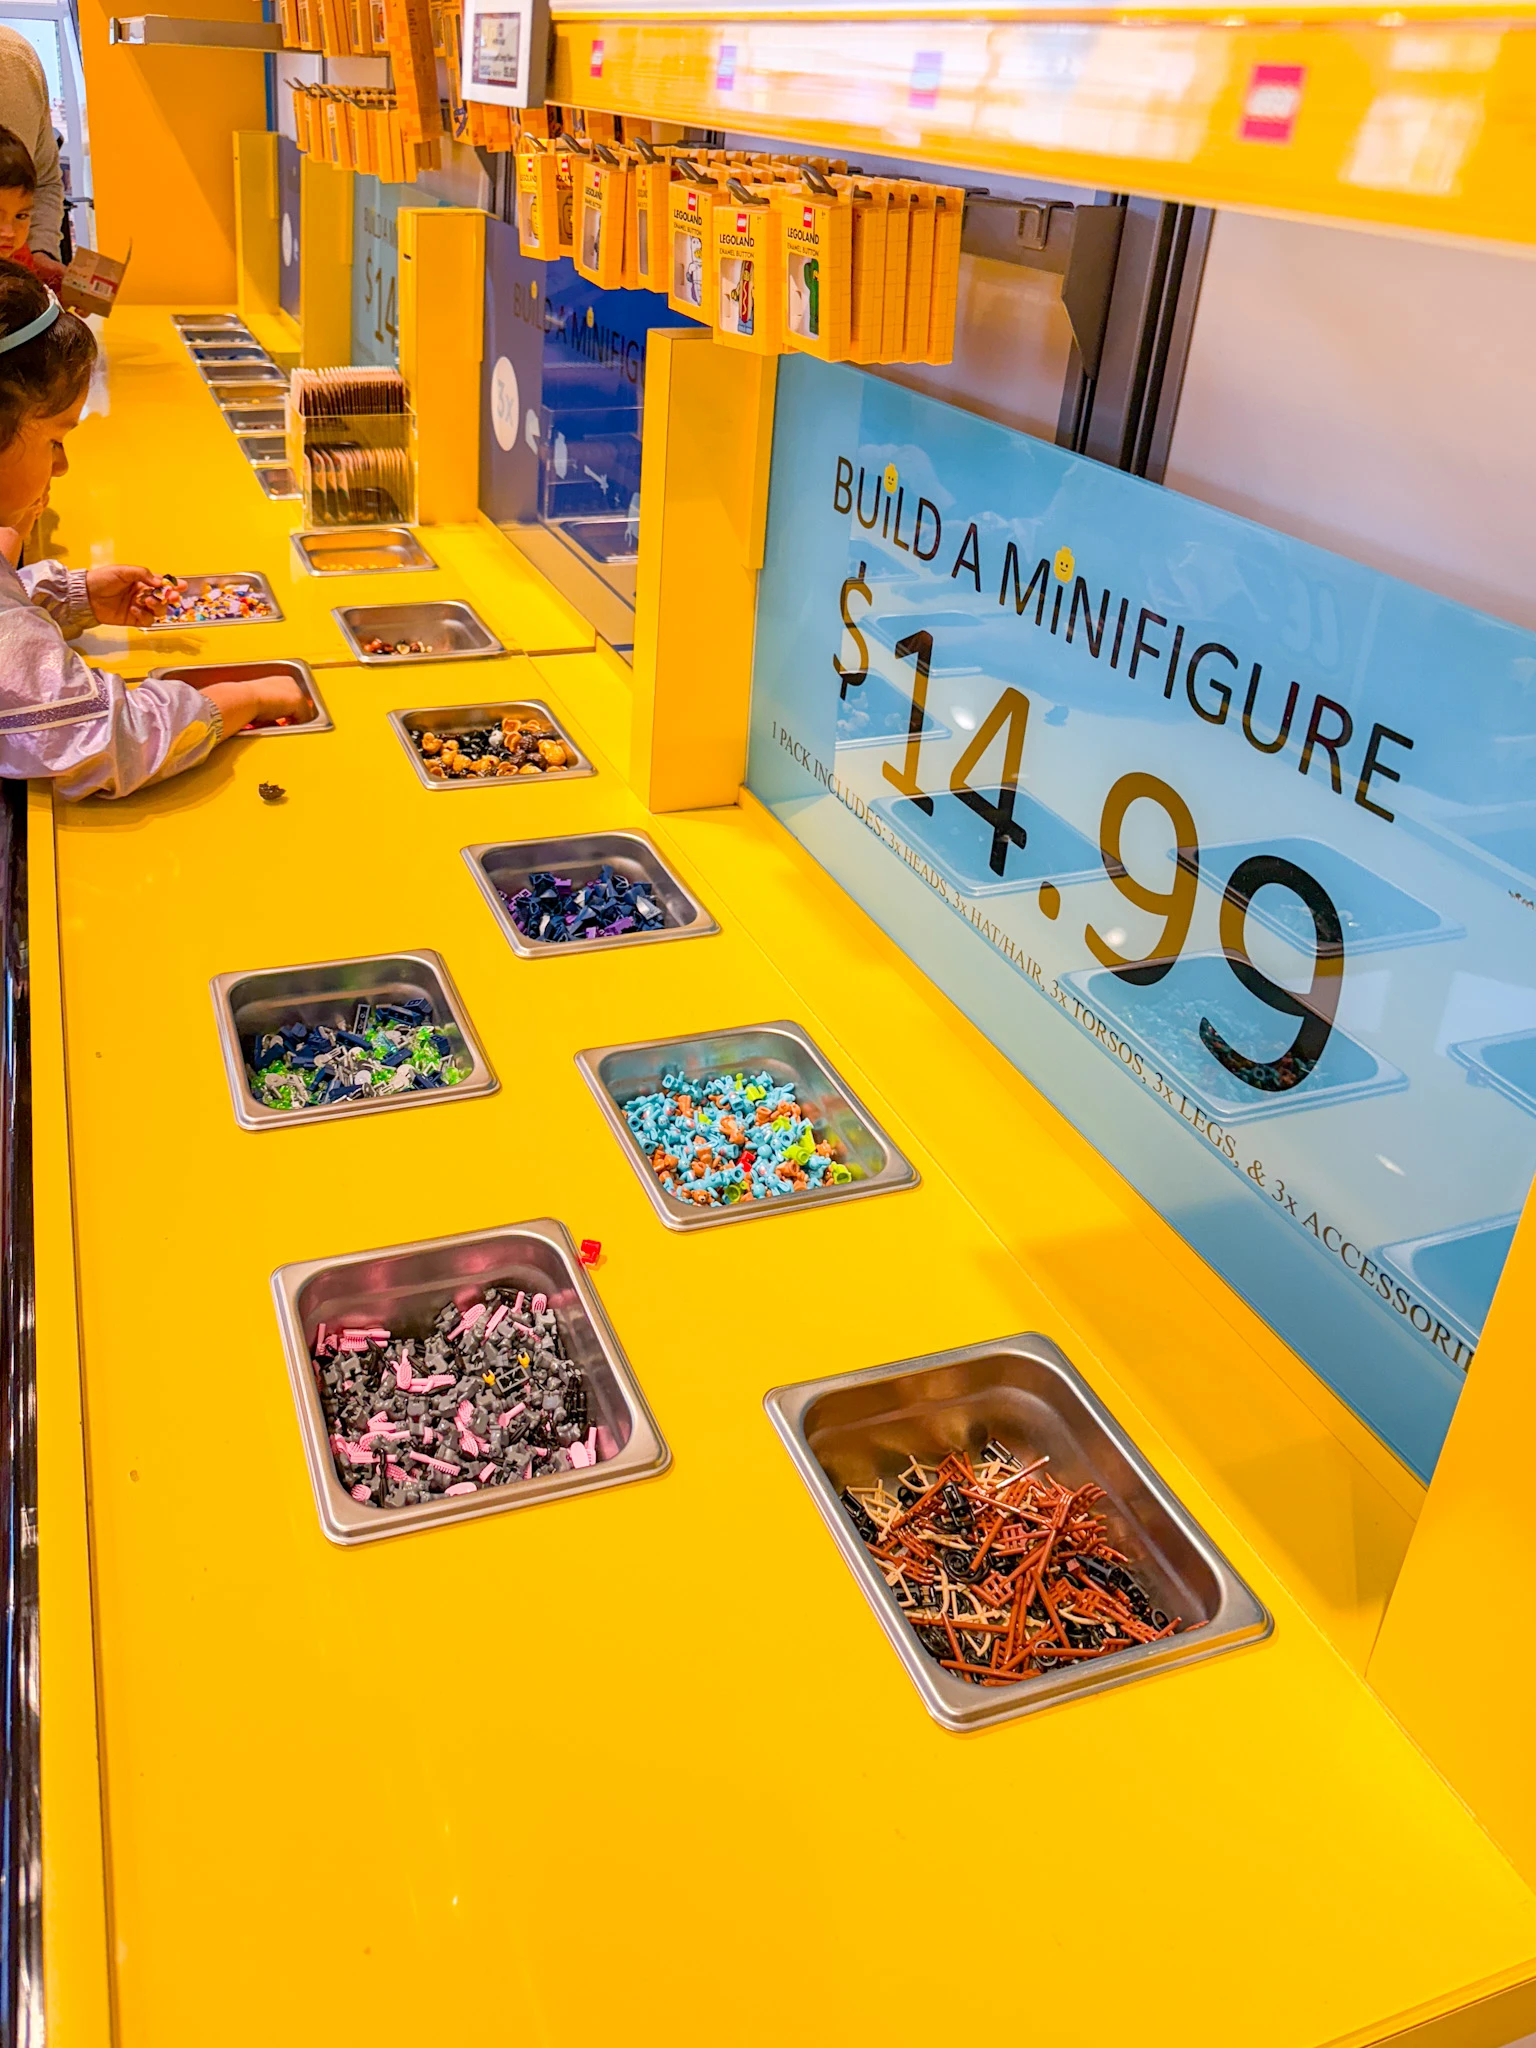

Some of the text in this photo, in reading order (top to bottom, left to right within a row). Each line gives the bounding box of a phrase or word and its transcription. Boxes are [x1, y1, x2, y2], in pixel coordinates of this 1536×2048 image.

[673, 209, 703, 226] LEGOLAND
[719, 233, 755, 248] LEGOLAND
[787, 227, 820, 245] LEGOLAND
[719, 248, 755, 259] ENAMEL BUTTON
[787, 243, 820, 257] ENAMEL BUTTON
[951, 522, 983, 593] A
[833, 560, 1345, 1093] $14.99
[772, 721, 777, 739] 1
[779, 727, 811, 773] PACK
[814, 758, 887, 842] INCLUDES:
[888, 832, 901, 856] 3x
[903, 846, 950, 903] HEADS,
[953, 891, 967, 917] 3x
[971, 907, 1046, 992] HAT/HAIR,
[1050, 980, 1067, 1008] 3x
[1072, 997, 1147, 1084] TORSOS,
[1152, 1072, 1174, 1105] 3x
[1179, 1094, 1240, 1168] LEGS,
[1247, 1160, 1266, 1187] &
[1271, 1179, 1298, 1217] 3x
